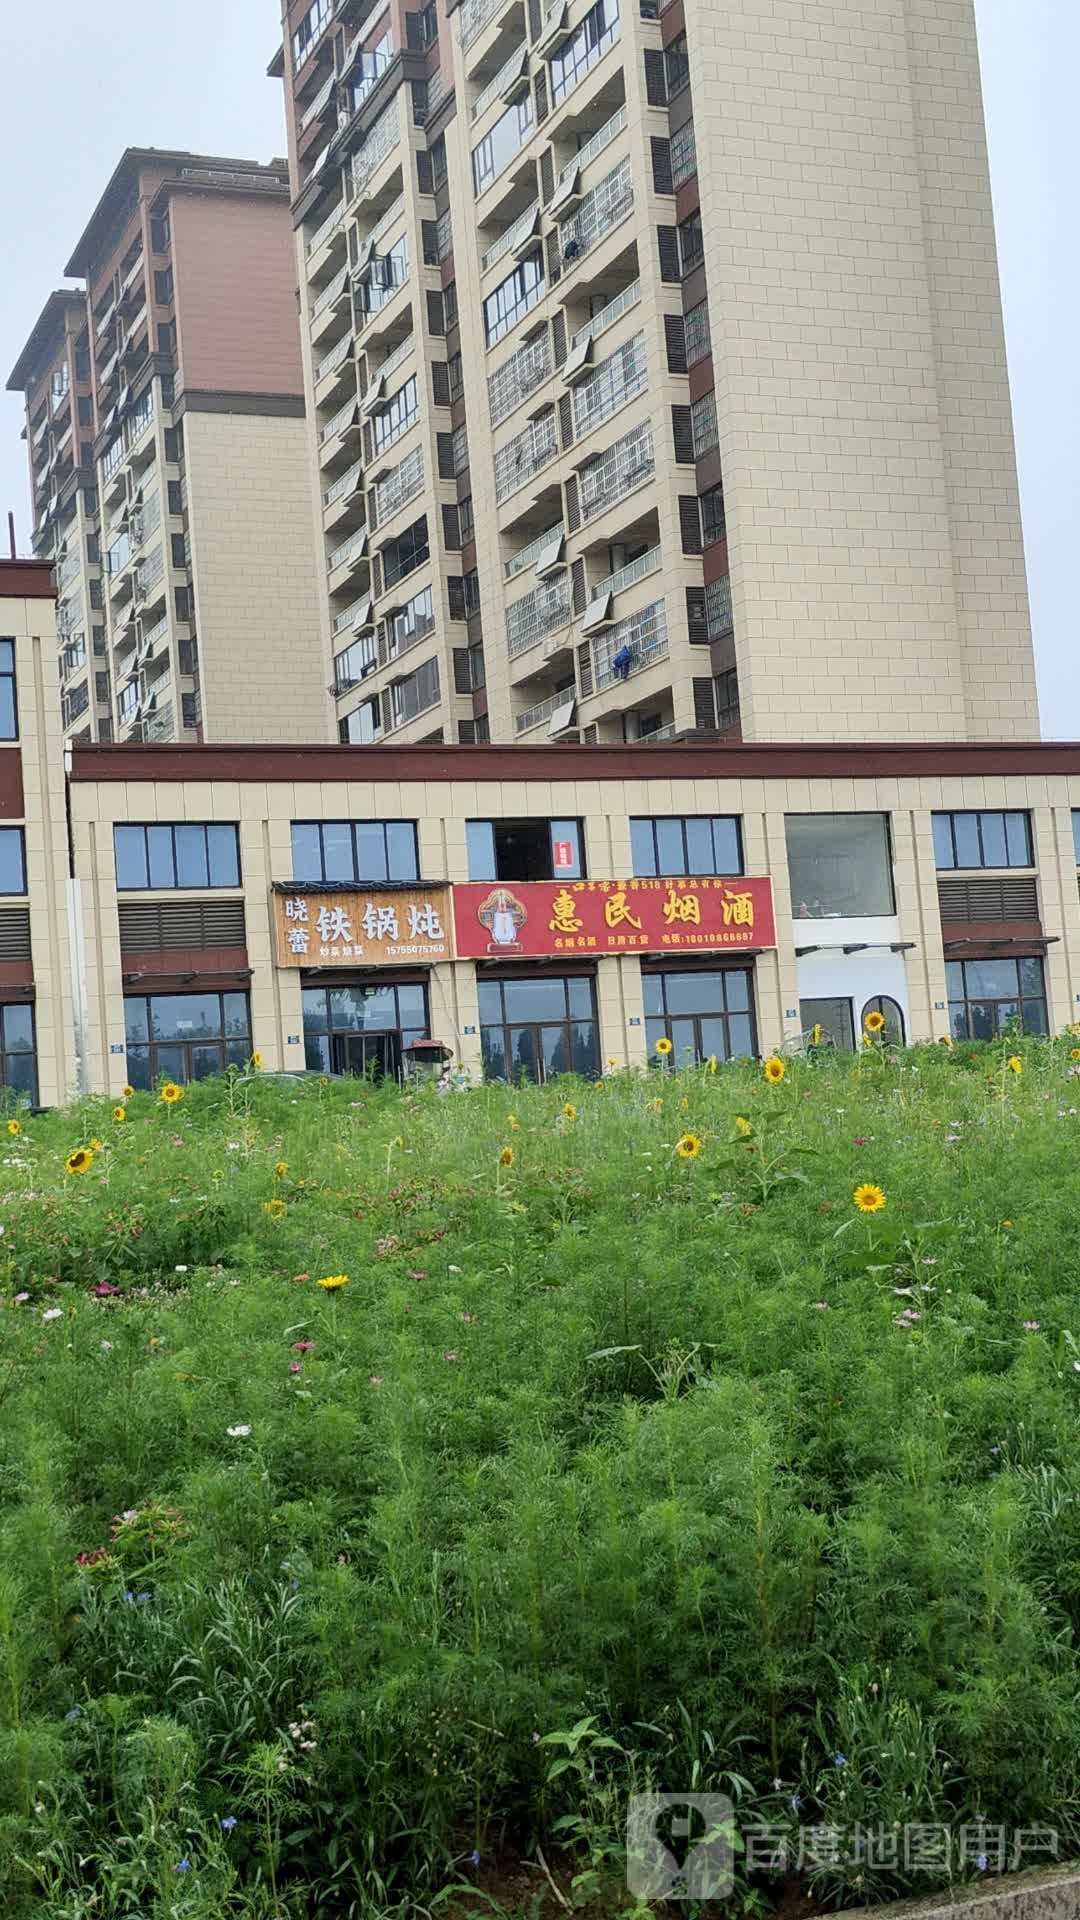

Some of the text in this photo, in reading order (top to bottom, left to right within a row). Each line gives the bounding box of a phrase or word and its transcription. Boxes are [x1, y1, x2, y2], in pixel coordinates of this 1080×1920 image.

[285, 896, 311, 954] 晓蕾
[316, 902, 445, 943] 铁锅炖
[548, 889, 755, 934] 惠民烟酒
[554, 935, 597, 948] 名烟名酒
[607, 934, 650, 946] 日用百货
